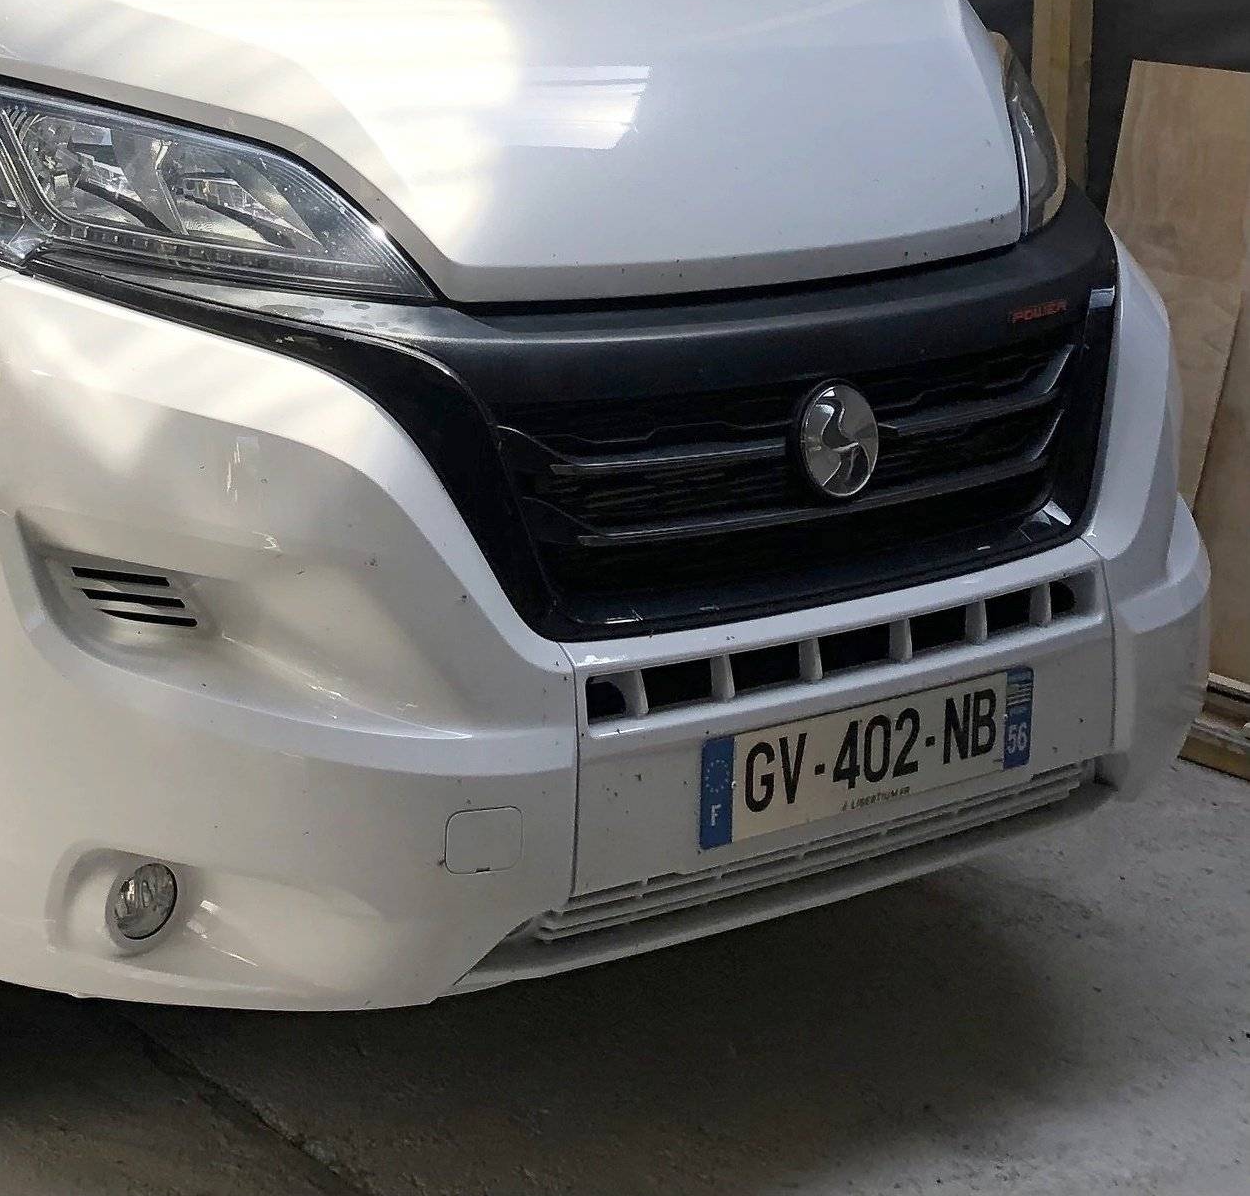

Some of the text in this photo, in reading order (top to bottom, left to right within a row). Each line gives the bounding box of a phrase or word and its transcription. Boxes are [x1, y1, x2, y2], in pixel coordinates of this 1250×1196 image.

[744, 687, 998, 814] GV-402-NB
[1006, 721, 1028, 755] 56
[709, 803, 723, 827] F
